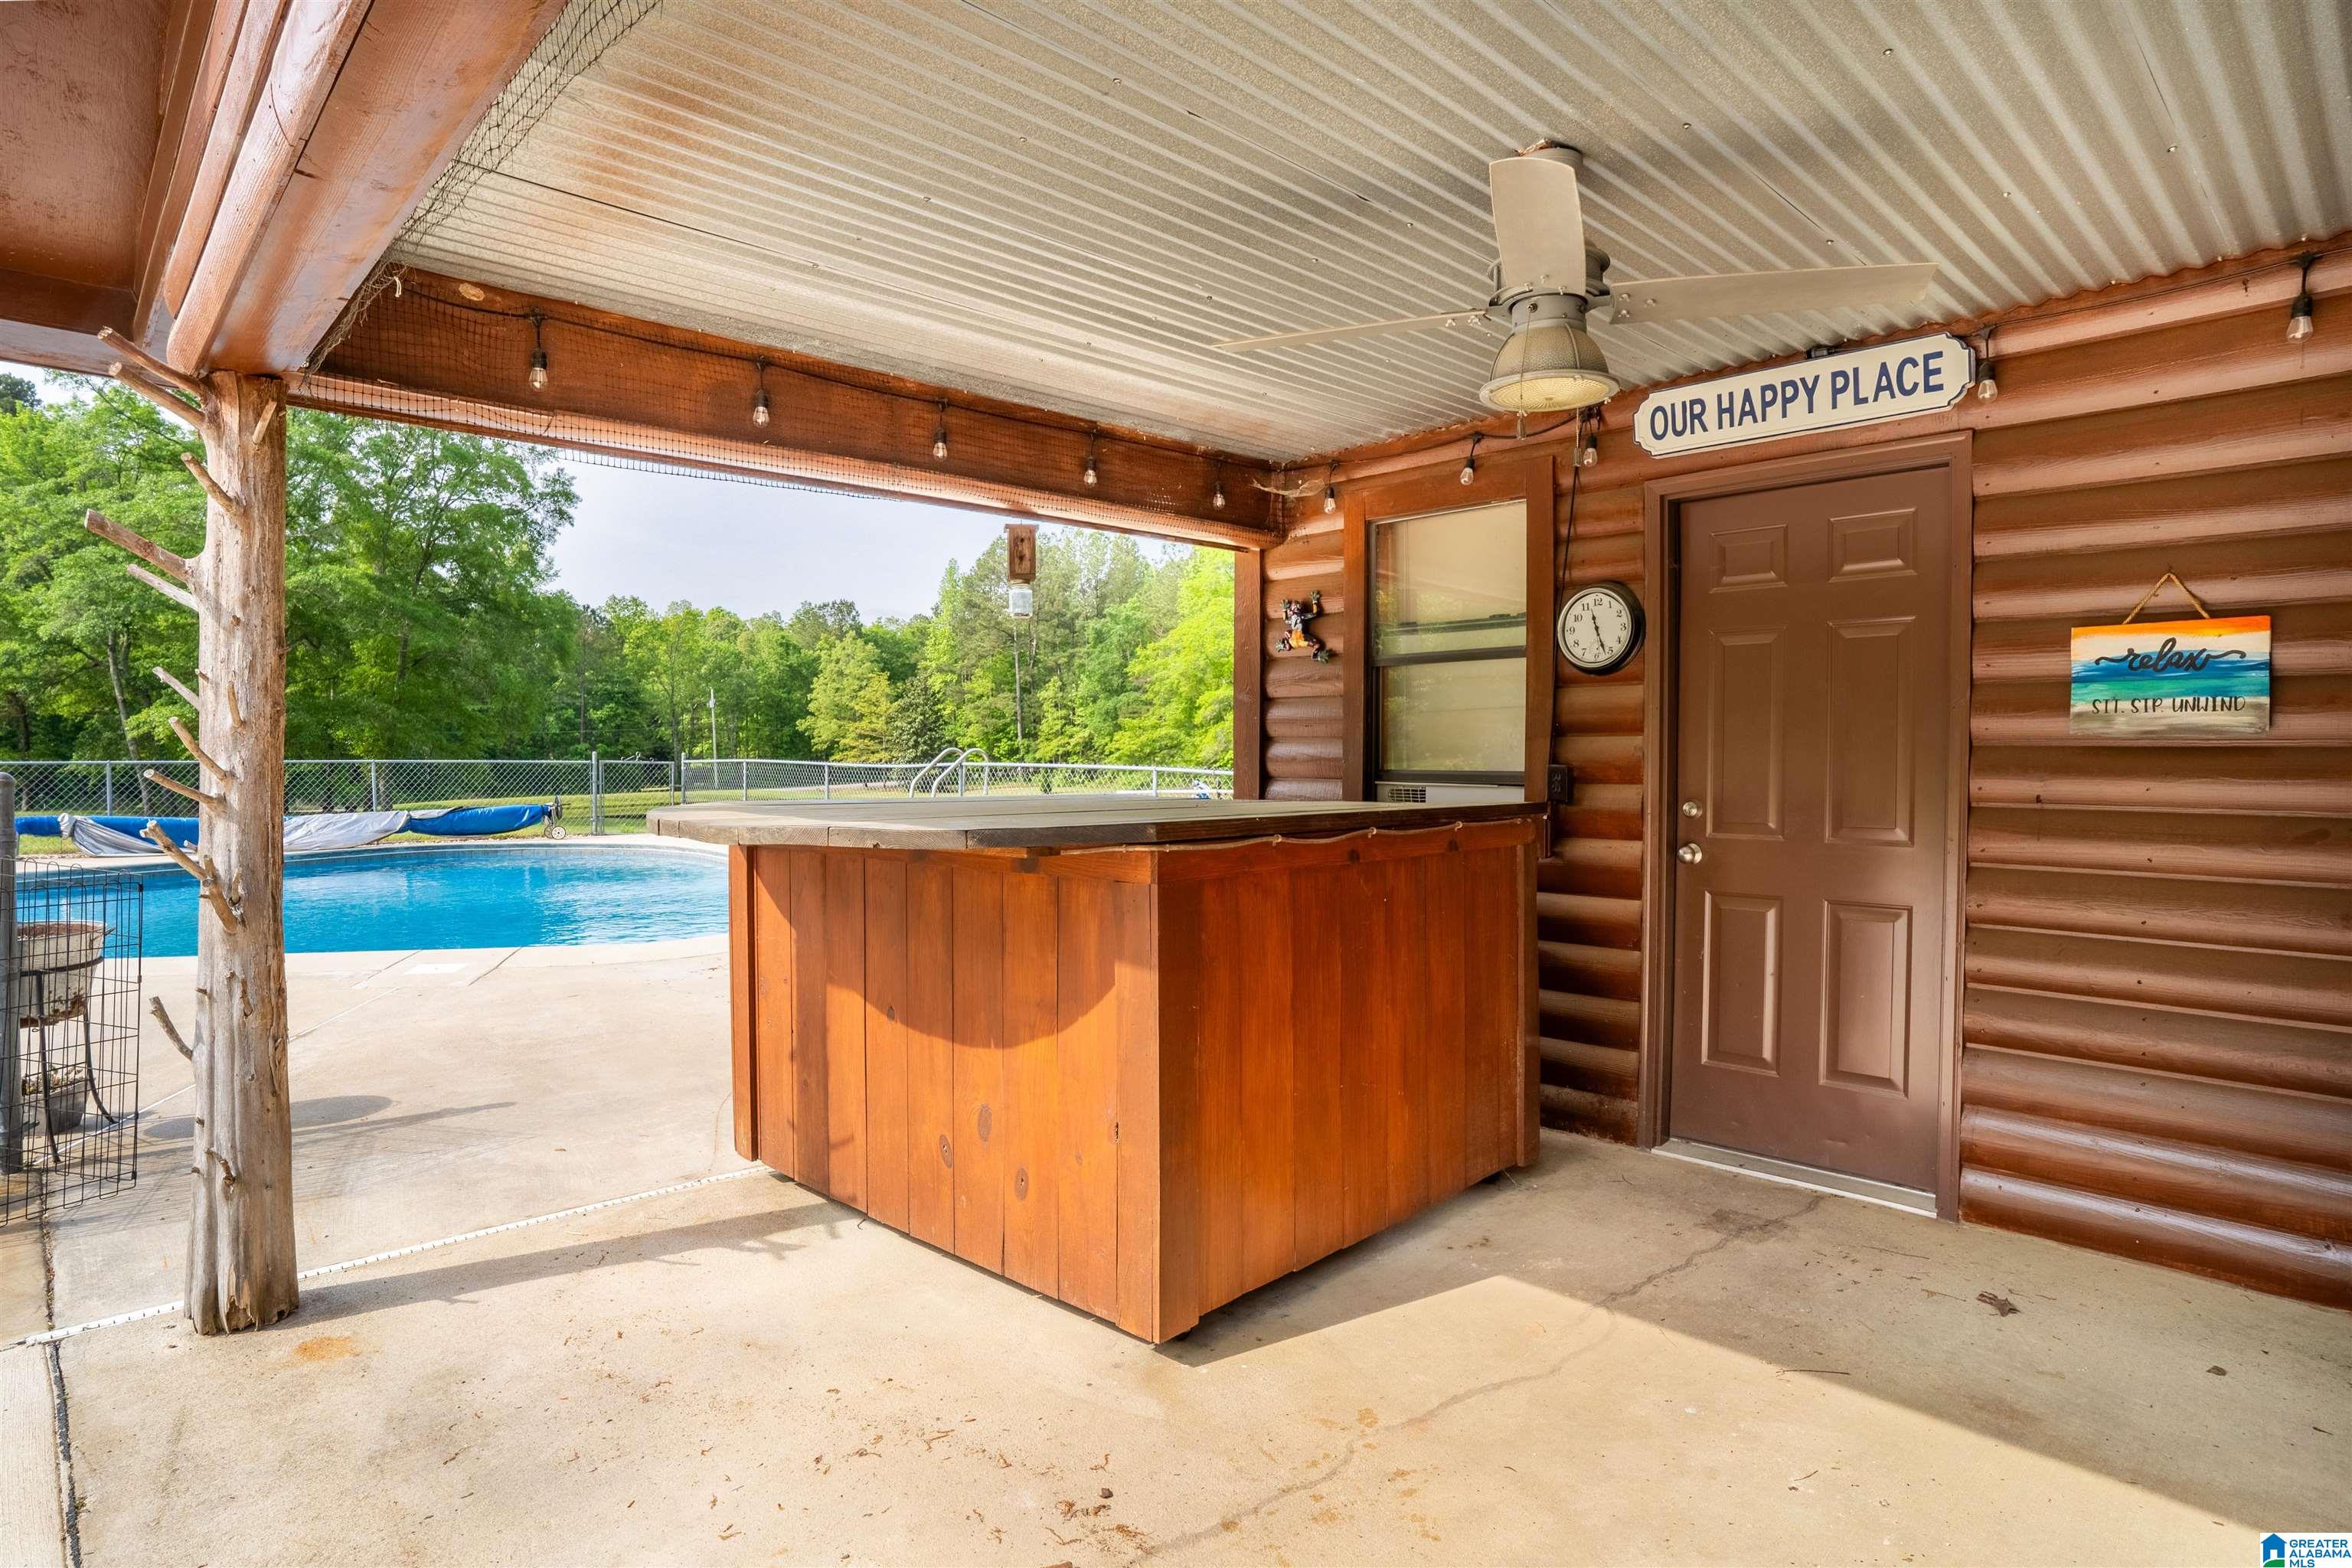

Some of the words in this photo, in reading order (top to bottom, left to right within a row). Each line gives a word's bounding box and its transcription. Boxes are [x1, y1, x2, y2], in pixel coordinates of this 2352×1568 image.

[1650, 398, 1709, 440] OUR
[1717, 374, 1820, 430] HAPPY
[1831, 351, 1944, 410] PLACE
[1592, 597, 1603, 606] 12
[1608, 600, 1612, 609] 1
[1582, 603, 1590, 611] 11
[1573, 614, 1583, 622] 10
[1616, 609, 1622, 618] 2
[1569, 626, 1576, 635] 9
[1620, 622, 1627, 631] 3
[1573, 639, 1579, 648] 8
[1581, 648, 1587, 656] 7
[1607, 647, 1614, 655] 5
[2094, 637, 2246, 672] relax
[2172, 695, 2246, 713] UNWIND
